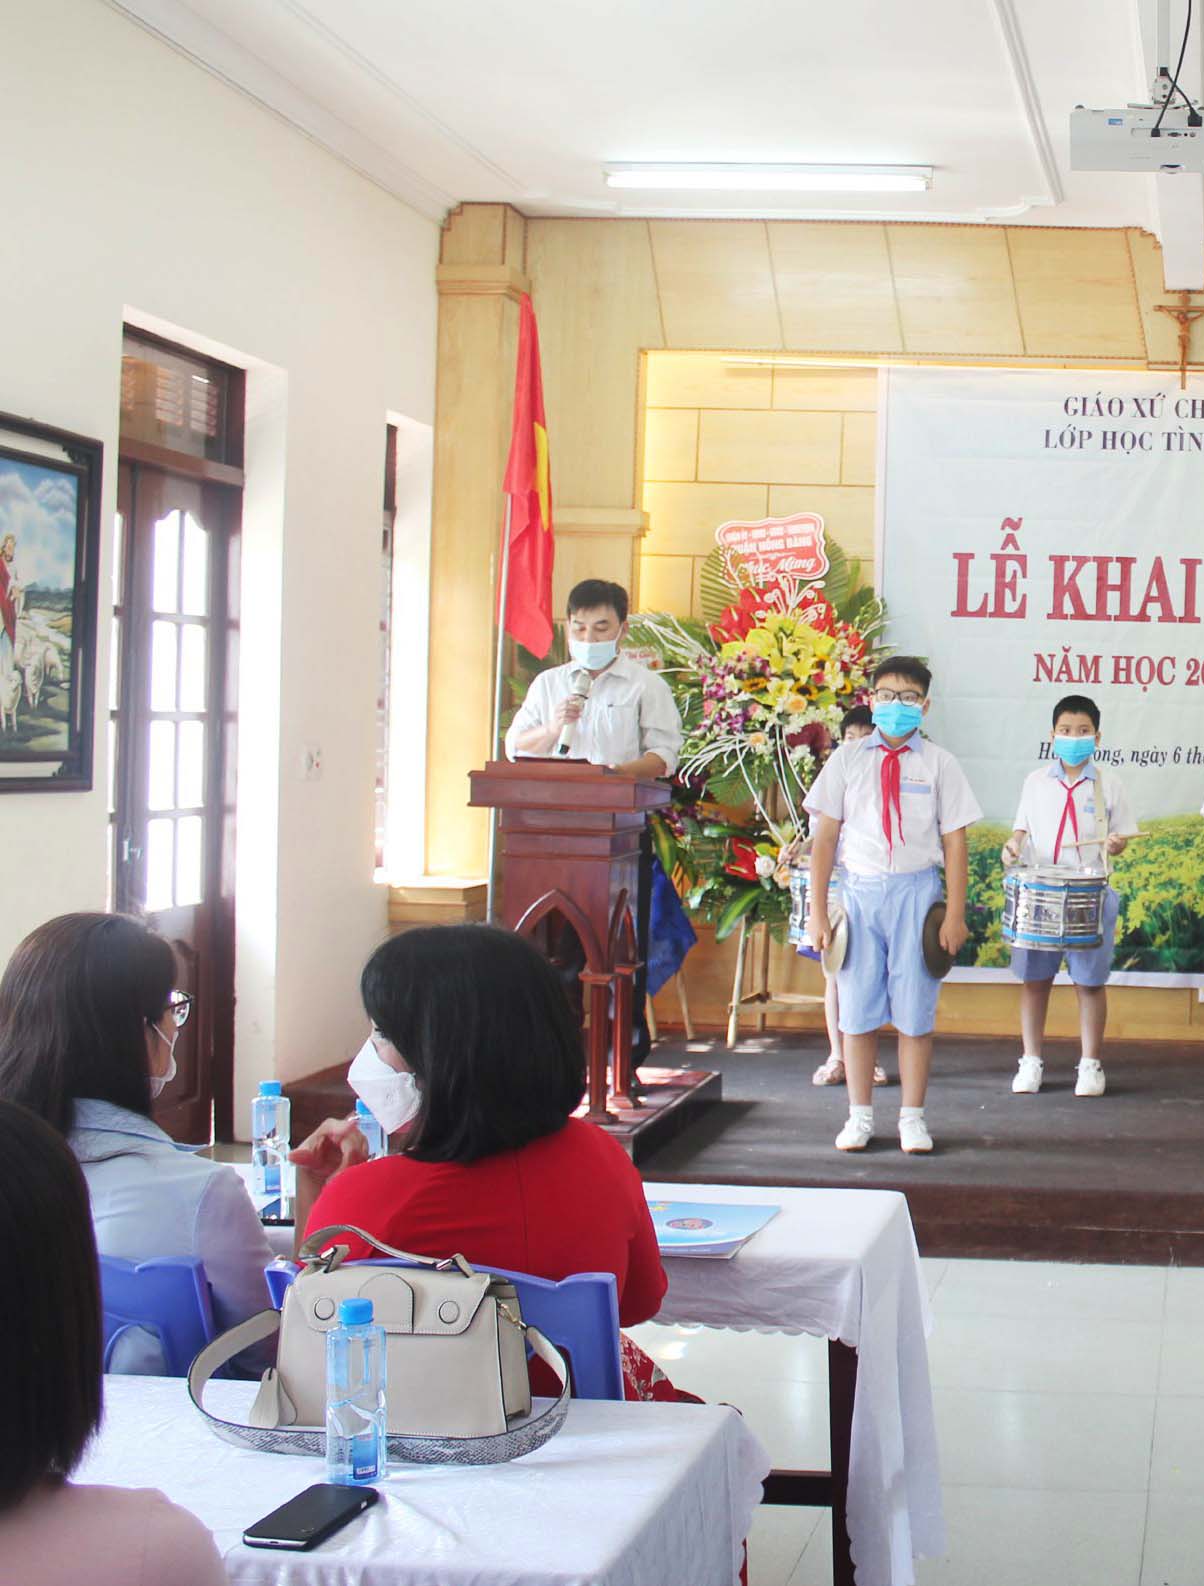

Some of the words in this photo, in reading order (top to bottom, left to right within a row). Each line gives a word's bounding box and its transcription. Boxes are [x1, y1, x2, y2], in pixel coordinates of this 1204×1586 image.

[1064, 391, 1124, 418] GIÁO
[1133, 391, 1167, 419] XỨ
[1043, 424, 1093, 450] LỚP
[1101, 430, 1153, 455] HỌC
[950, 516, 1027, 619] LỄ
[1046, 554, 1203, 624] KHAI
[1032, 645, 1103, 684] NĂM
[1110, 655, 1176, 693] HỌC
[1130, 745, 1168, 768] ngày
[1173, 745, 1182, 765] 6
